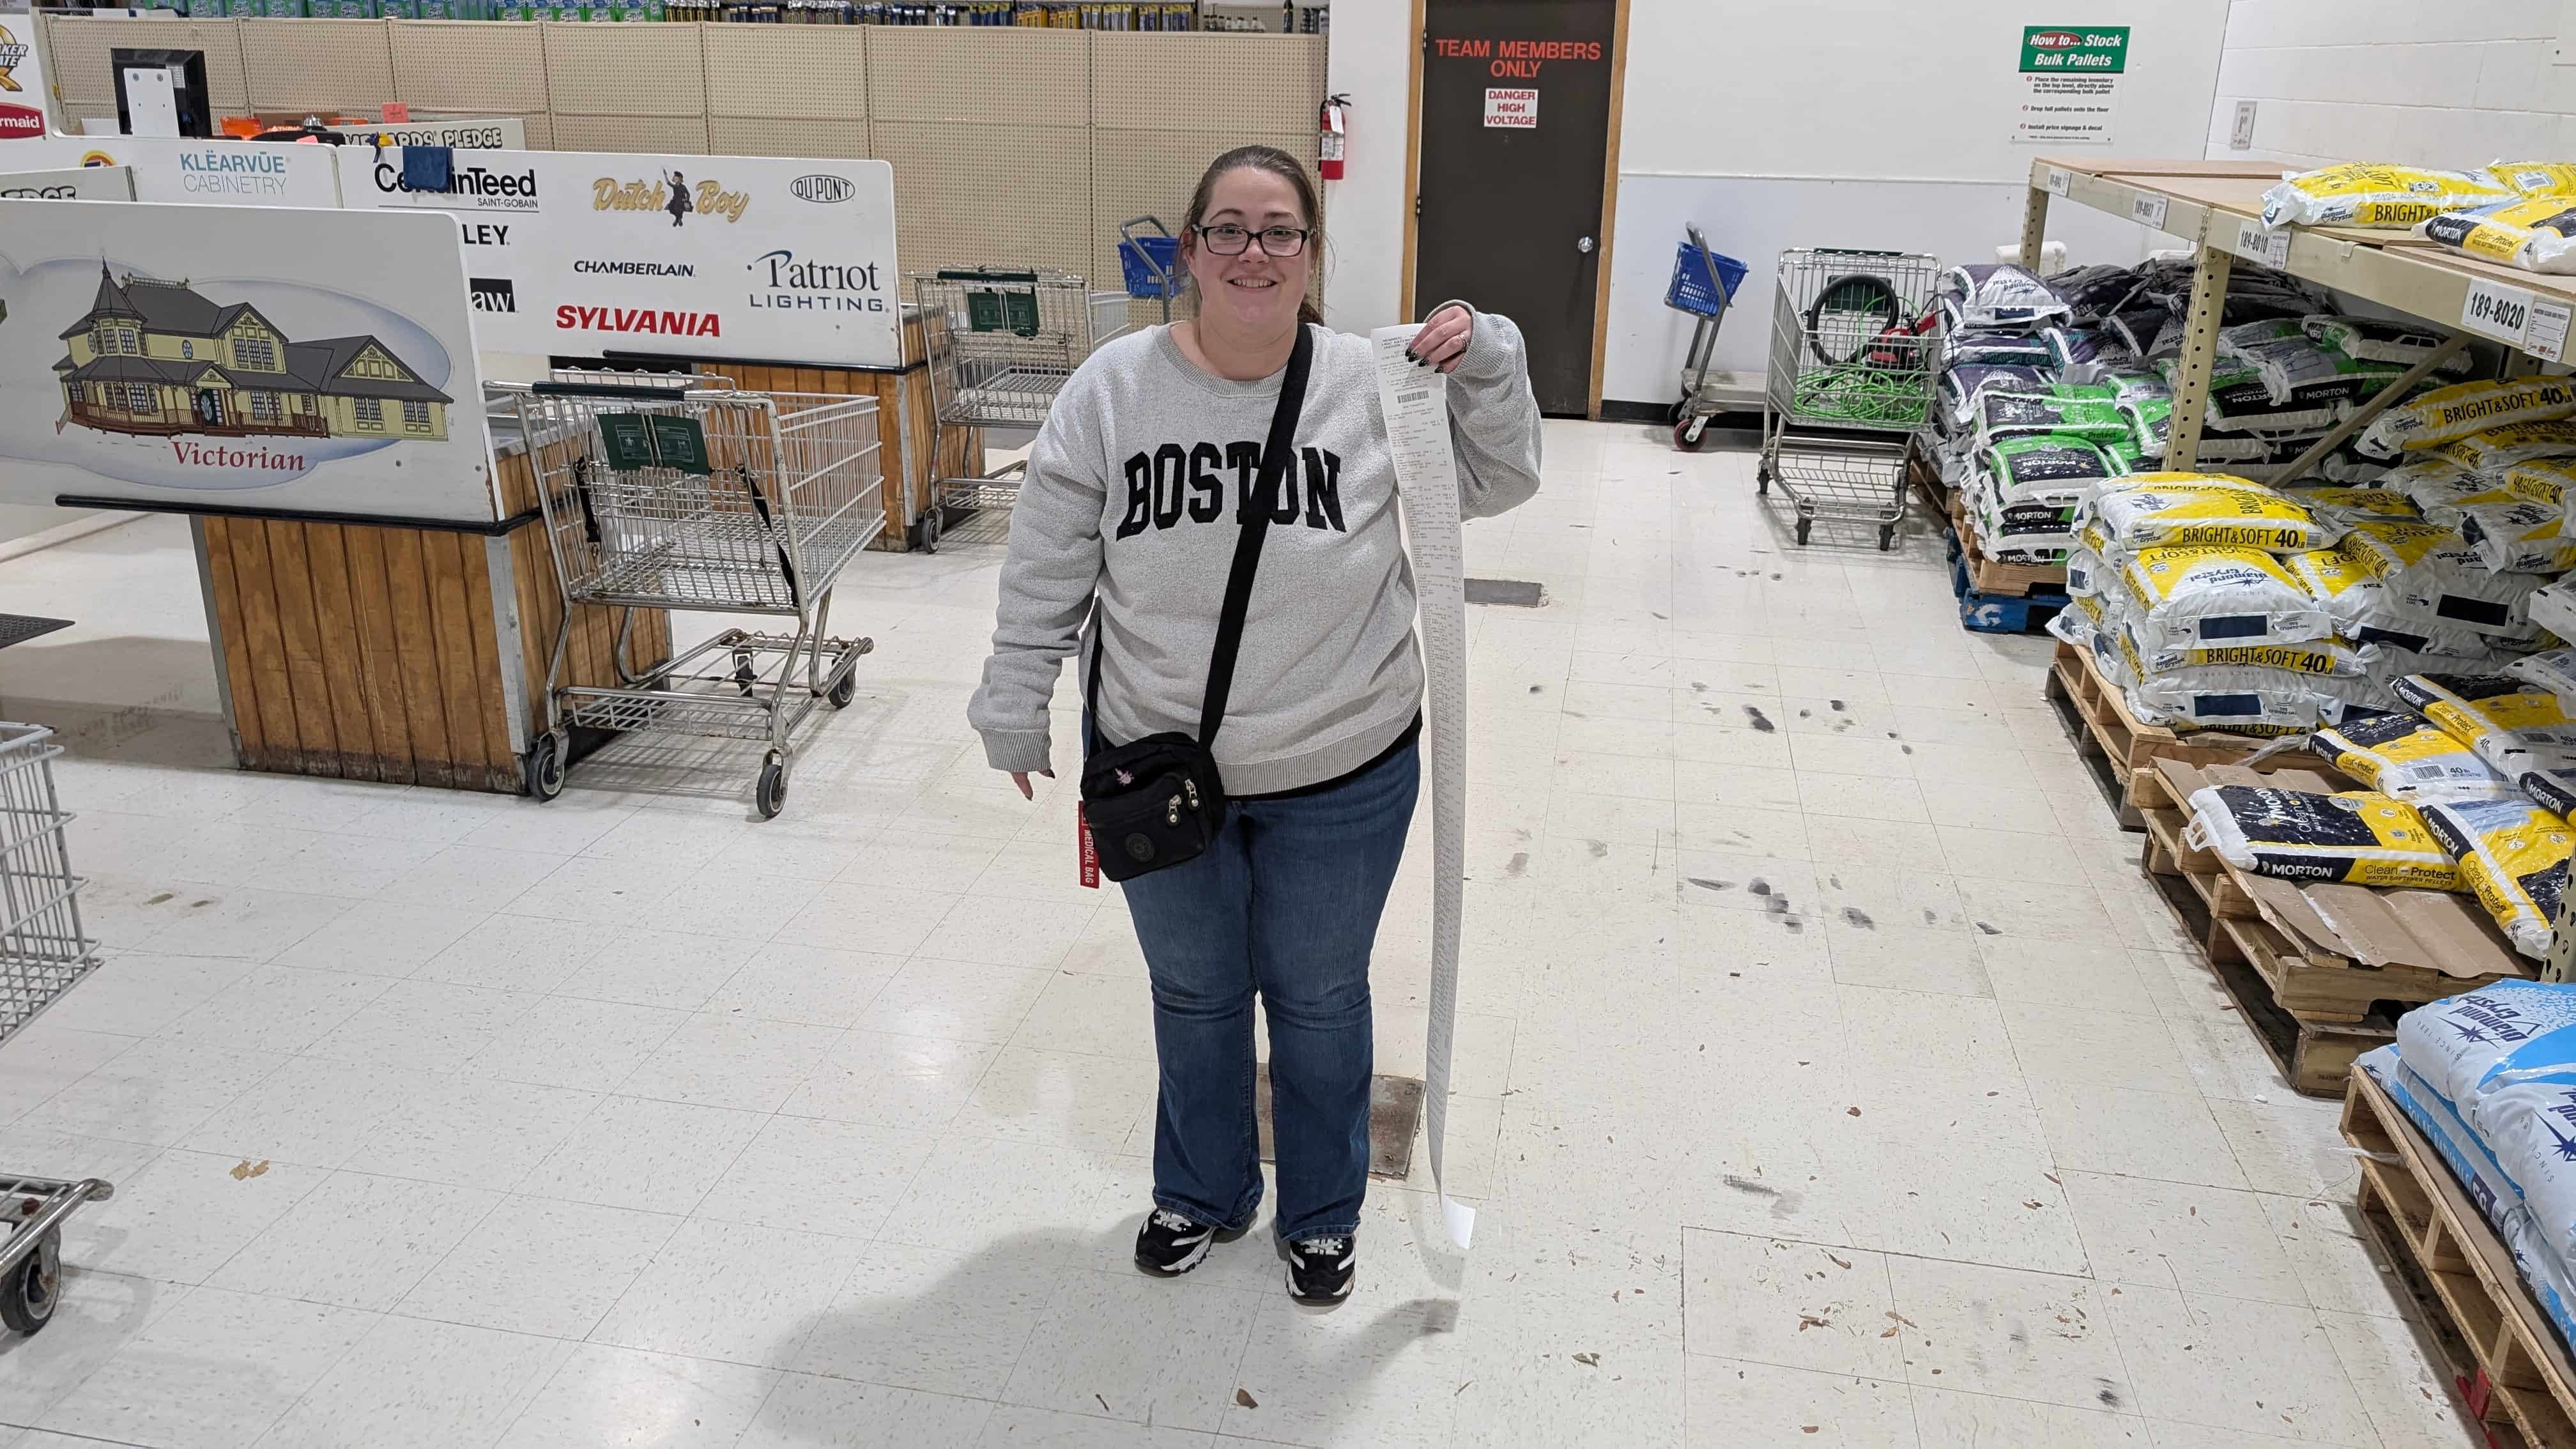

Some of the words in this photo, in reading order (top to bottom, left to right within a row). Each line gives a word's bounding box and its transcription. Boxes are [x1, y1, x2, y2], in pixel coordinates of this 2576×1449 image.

[1436, 39, 1491, 57] TEAM
[1499, 40, 1601, 60] MEMBERS
[2030, 34, 2056, 45] How
[2084, 34, 2122, 47] Stock
[1490, 60, 1541, 78] ONLY
[2034, 54, 2064, 66] Bulk
[2066, 54, 2112, 66] Pallets
[1488, 90, 1536, 101] DANGER
[1497, 103, 1526, 113] HIGH
[1486, 116, 1536, 125] VOLTAGE
[442, 127, 502, 149] PLEDGE
[183, 174, 286, 194] CABINETRY
[374, 164, 537, 197] CeinTeed
[477, 197, 538, 208] SAINT-GOBAIN
[593, 177, 665, 211] Dutch
[695, 180, 749, 223] Boy
[462, 224, 509, 246] LEY
[2241, 231, 2269, 254] 189-8010
[574, 261, 694, 277] CHAMBERLAIN
[755, 250, 880, 291] Patriot
[749, 294, 883, 312] LIGHTING
[2471, 292, 2525, 330] 189-8020
[556, 305, 721, 337] SYLVANIA
[2306, 387, 2350, 399] MORTON
[2444, 392, 2534, 424] BRIGHT&SOFT
[171, 441, 306, 471] Victorian
[2022, 459, 2076, 467] MORTON
[1116, 441, 1347, 542] BOSTON
[2013, 511, 2051, 521] MORTON
[2182, 526, 2272, 546] BRIGHT&SOFT
[2189, 567, 2242, 582] Crystal
[2209, 572, 2269, 585] Diamond
[2206, 648, 2297, 668] BRIGHT&SOFT
[2398, 686, 2425, 707] MORTON
[2528, 786, 2564, 814] MORTON
[1084, 829, 1094, 864] MEDICAL
[2428, 818, 2460, 857] MORTON
[1085, 866, 1094, 884] BAG
[2272, 864, 2333, 877] MORTON
[2365, 864, 2398, 875] Clean
[2411, 866, 2456, 880] Protect
[2468, 860, 2485, 885] Clean
[2448, 1005, 2529, 1043] Diamond
[2434, 1038, 2462, 1061] SINCE
